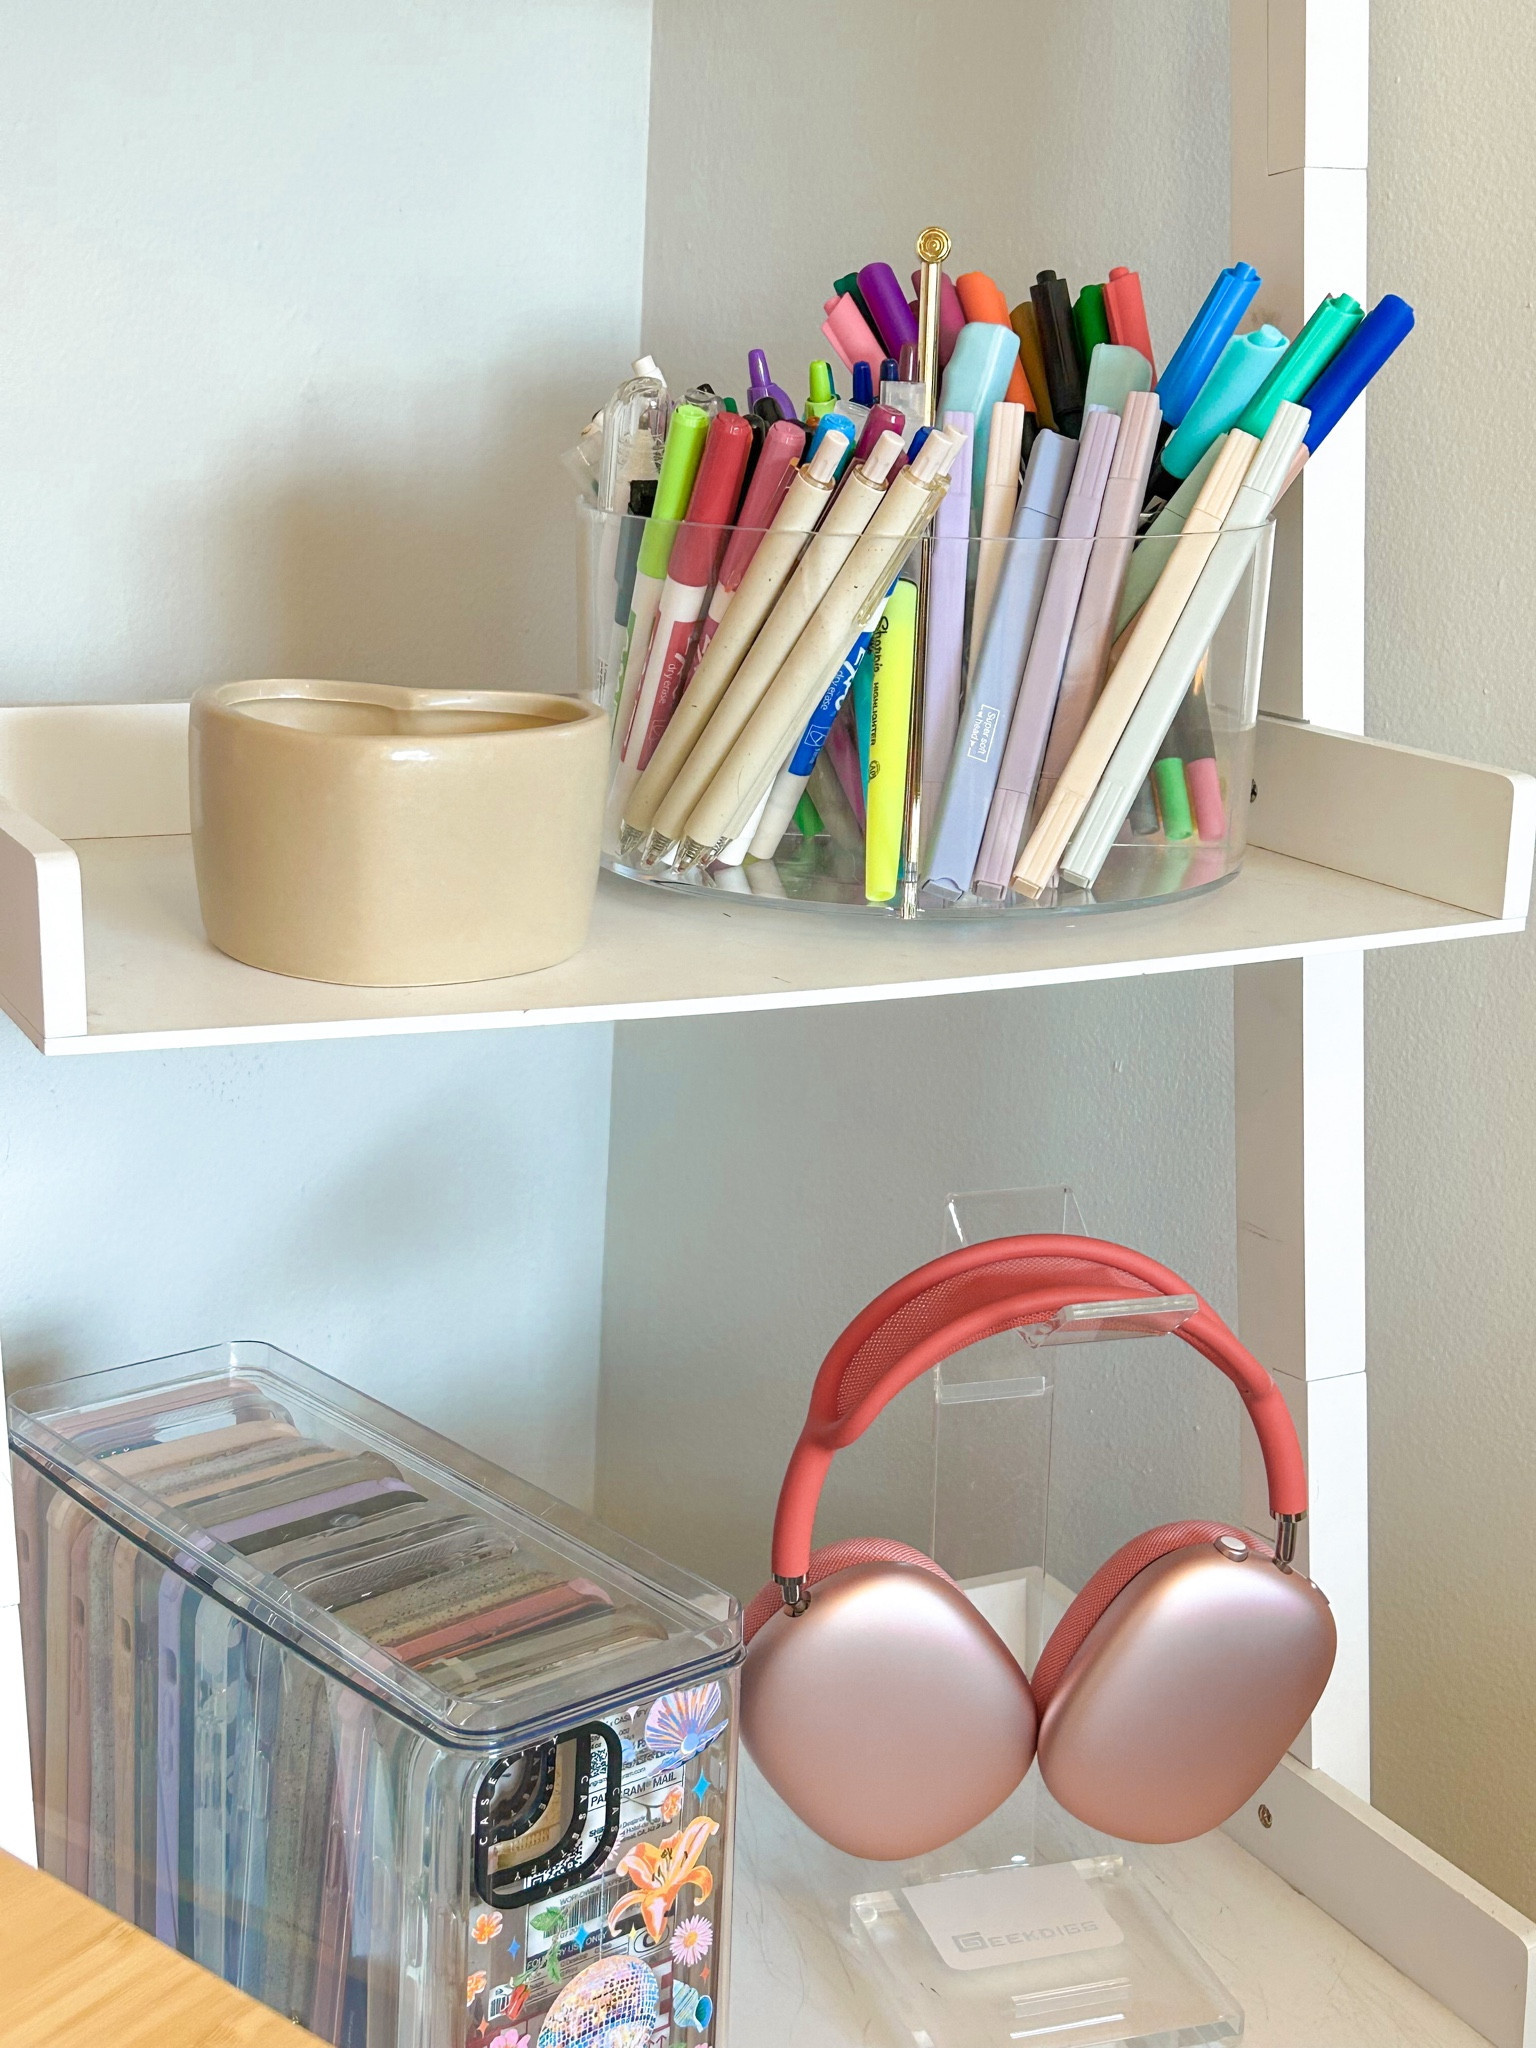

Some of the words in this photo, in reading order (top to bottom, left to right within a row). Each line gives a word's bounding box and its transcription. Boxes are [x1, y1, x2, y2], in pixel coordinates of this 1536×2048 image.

[663, 663, 677, 679] dry
[831, 670, 845, 688] dry
[658, 680, 671, 704] erase
[820, 686, 836, 711] erase
[970, 718, 983, 741] head
[983, 711, 996, 738] Super
[977, 737, 988, 755] soft
[652, 1772, 677, 1789] MAIL
[585, 1931, 607, 1946] ONLY
